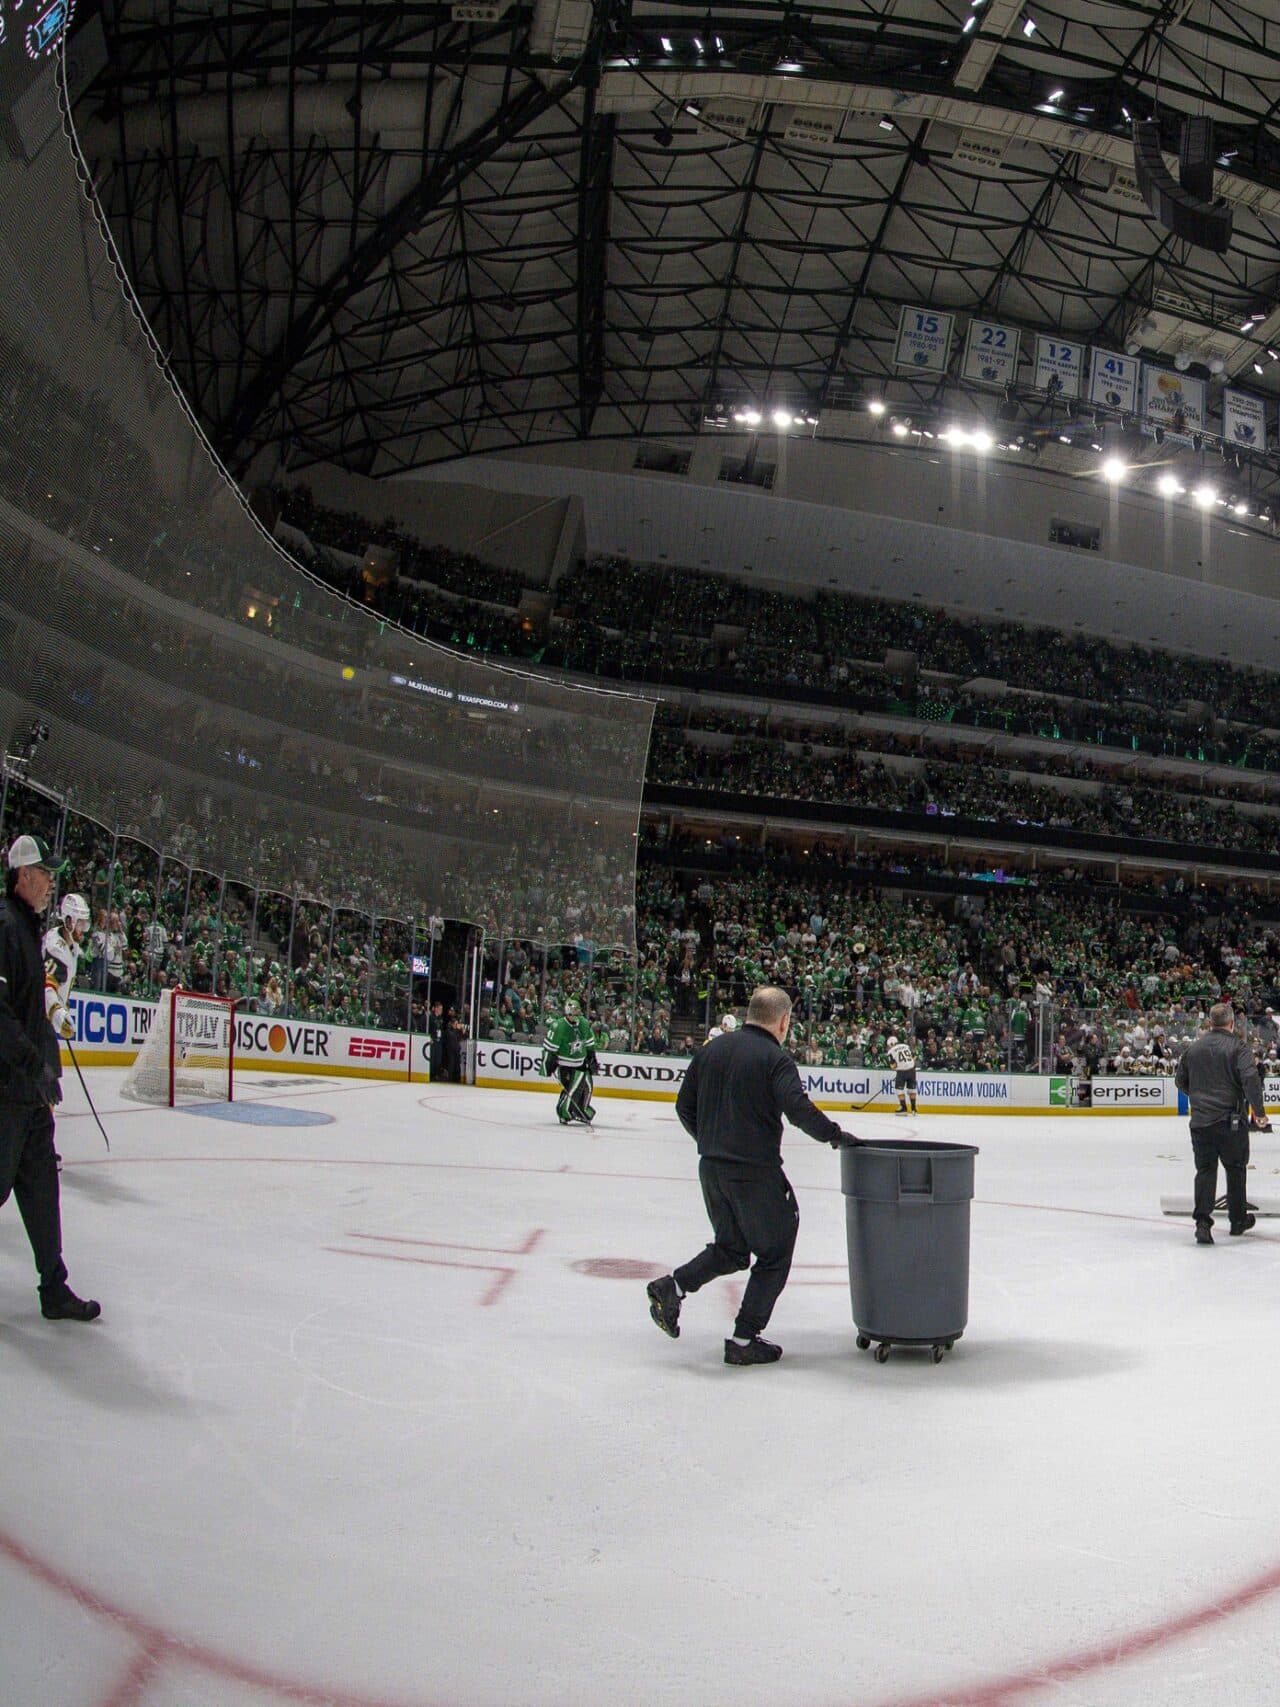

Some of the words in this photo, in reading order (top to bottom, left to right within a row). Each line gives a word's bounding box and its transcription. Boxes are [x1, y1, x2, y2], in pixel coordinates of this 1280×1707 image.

[916, 314, 938, 332] 15
[981, 327, 1007, 348] 22
[1048, 344, 1072, 361] 12
[1104, 358, 1125, 376] 41
[348, 1036, 406, 1061] ESPN
[491, 1048, 544, 1076] Clips
[976, 1082, 1008, 1099] VODKA
